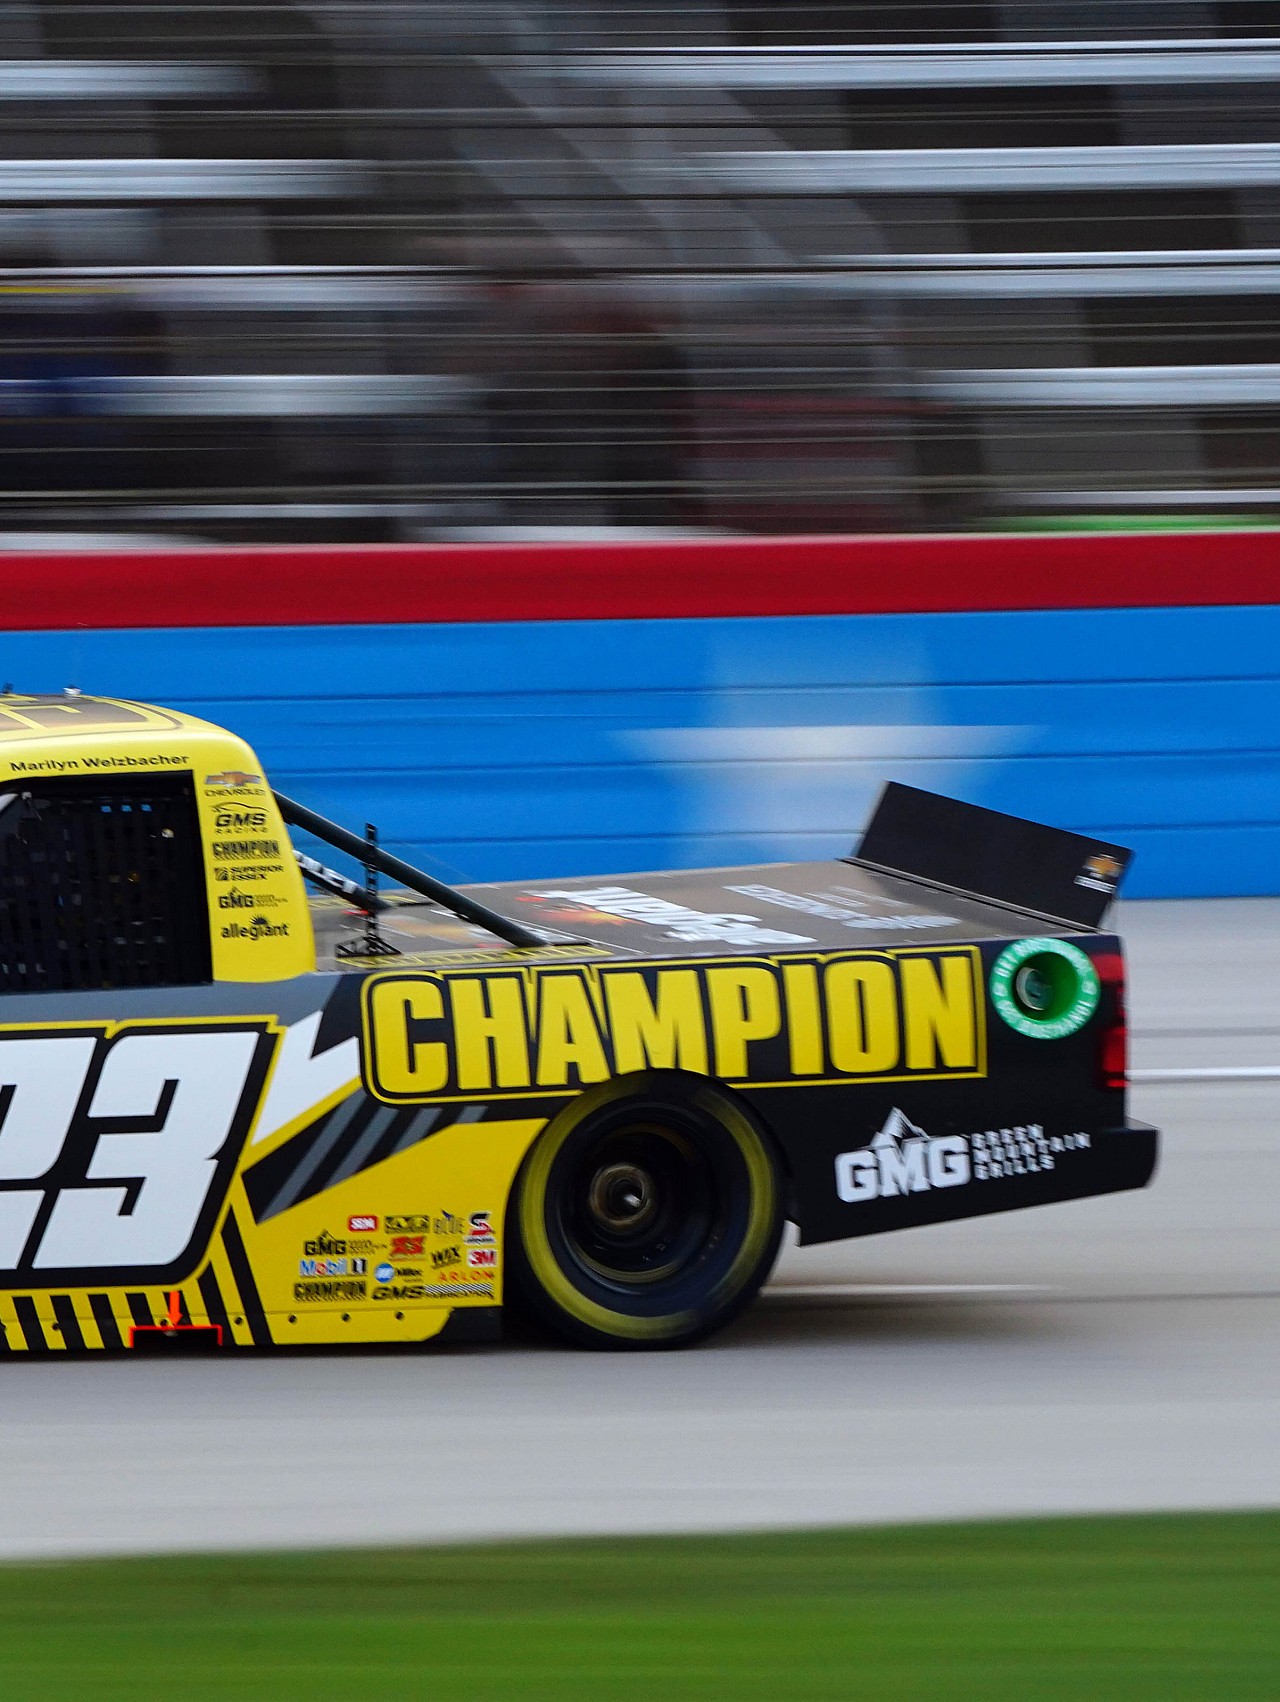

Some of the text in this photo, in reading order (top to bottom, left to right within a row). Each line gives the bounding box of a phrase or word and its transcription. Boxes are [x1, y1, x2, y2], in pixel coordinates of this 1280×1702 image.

[9, 754, 190, 773] Marilyn Welzbacher
[215, 813, 266, 827] GMS
[218, 894, 255, 908] GMG
[221, 922, 290, 941] allegiant
[371, 955, 977, 1093] CHAMPION
[834, 1135, 971, 1203] GMG
[304, 1239, 347, 1256] GMG
[299, 1258, 348, 1277] Mobil
[372, 1285, 425, 1300] GMS
